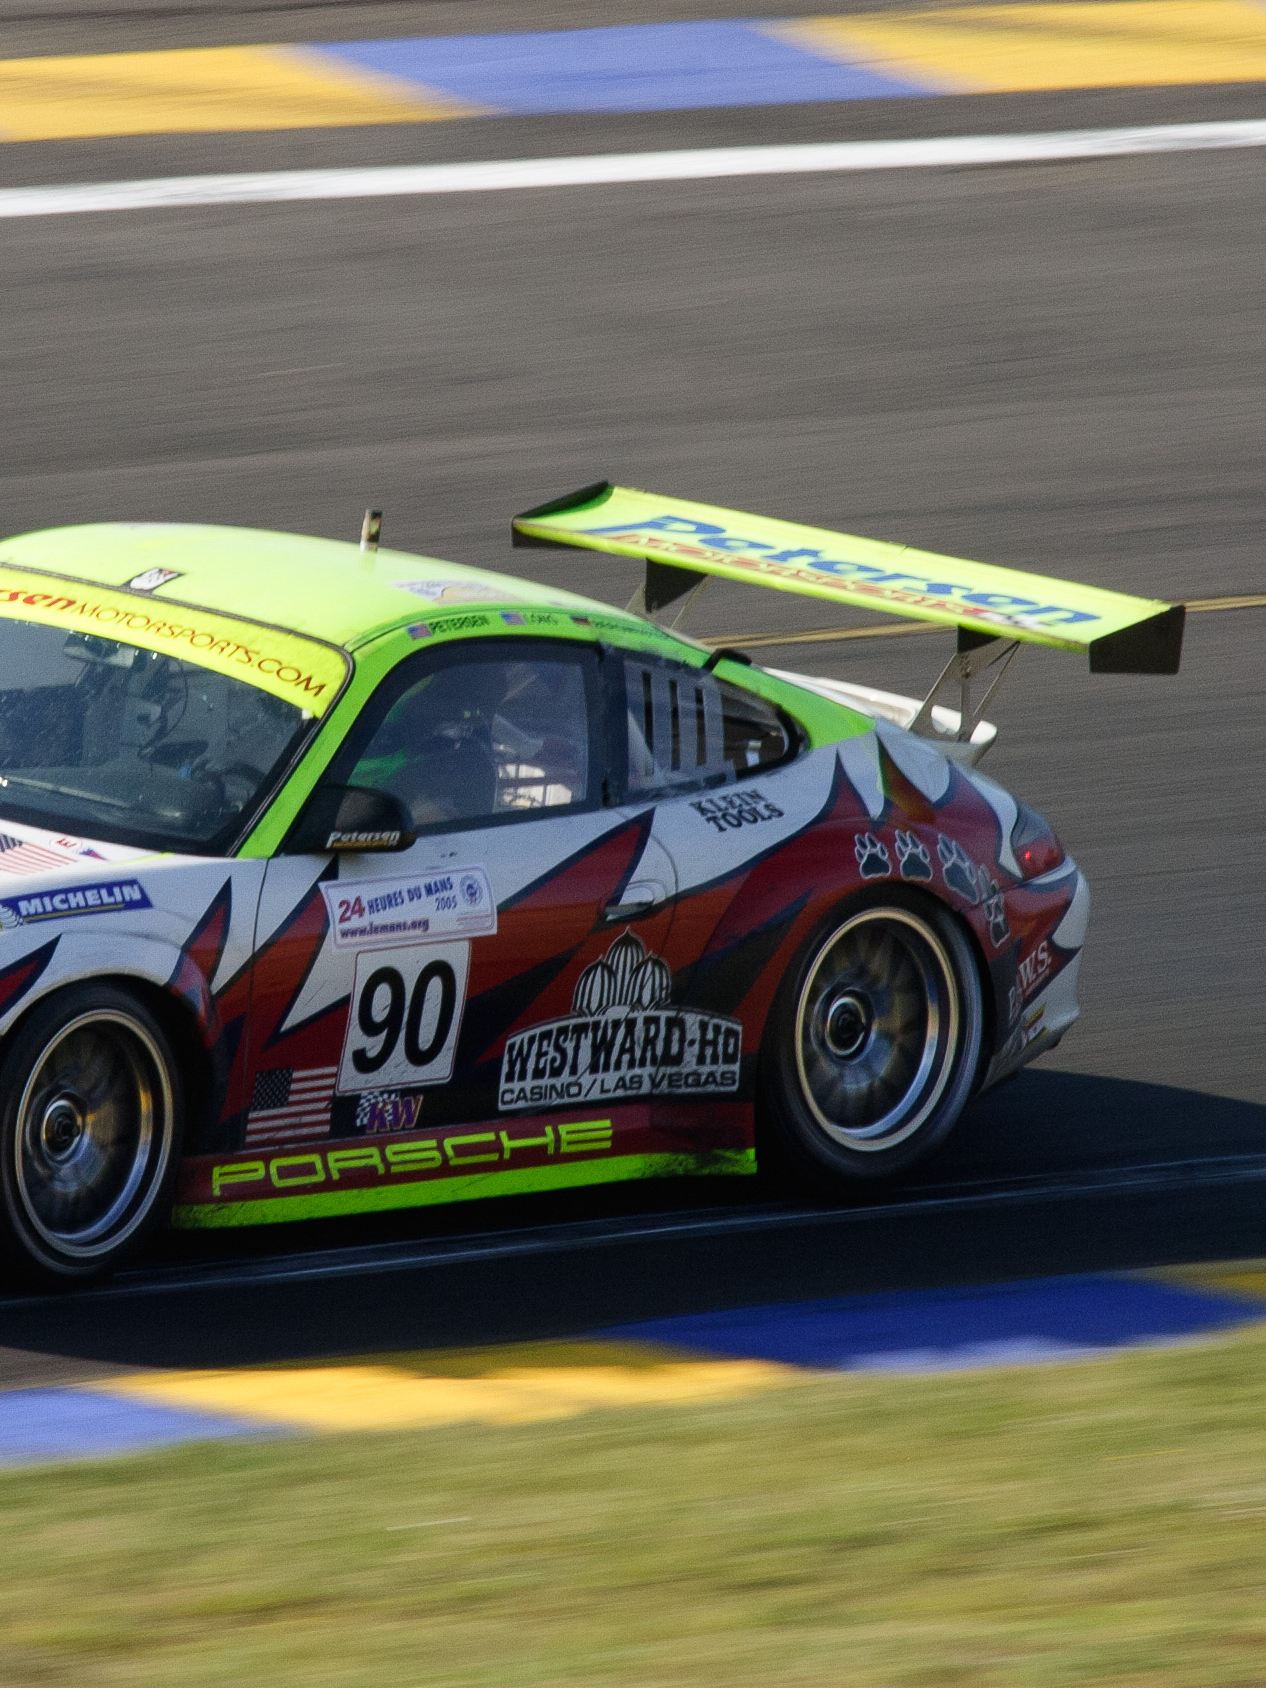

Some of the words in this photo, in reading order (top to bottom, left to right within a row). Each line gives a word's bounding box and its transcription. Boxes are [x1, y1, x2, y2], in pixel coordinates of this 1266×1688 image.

[582, 514, 1102, 624] Petersen
[705, 803, 784, 833] TOOLS
[17, 884, 144, 917] MICHELIN
[337, 895, 366, 924] 24
[367, 888, 405, 916] HEURES
[406, 884, 423, 902] DU
[423, 876, 454, 898] MANS
[435, 894, 459, 912] 2005
[339, 917, 430, 940] www.lemans.org
[352, 959, 457, 1074] 90
[500, 1081, 583, 1107] CASINO
[599, 1073, 643, 1095] LAS
[648, 1070, 737, 1091] VEGAS
[365, 1094, 424, 1134] KW
[212, 1118, 614, 1197] PORSCHE
